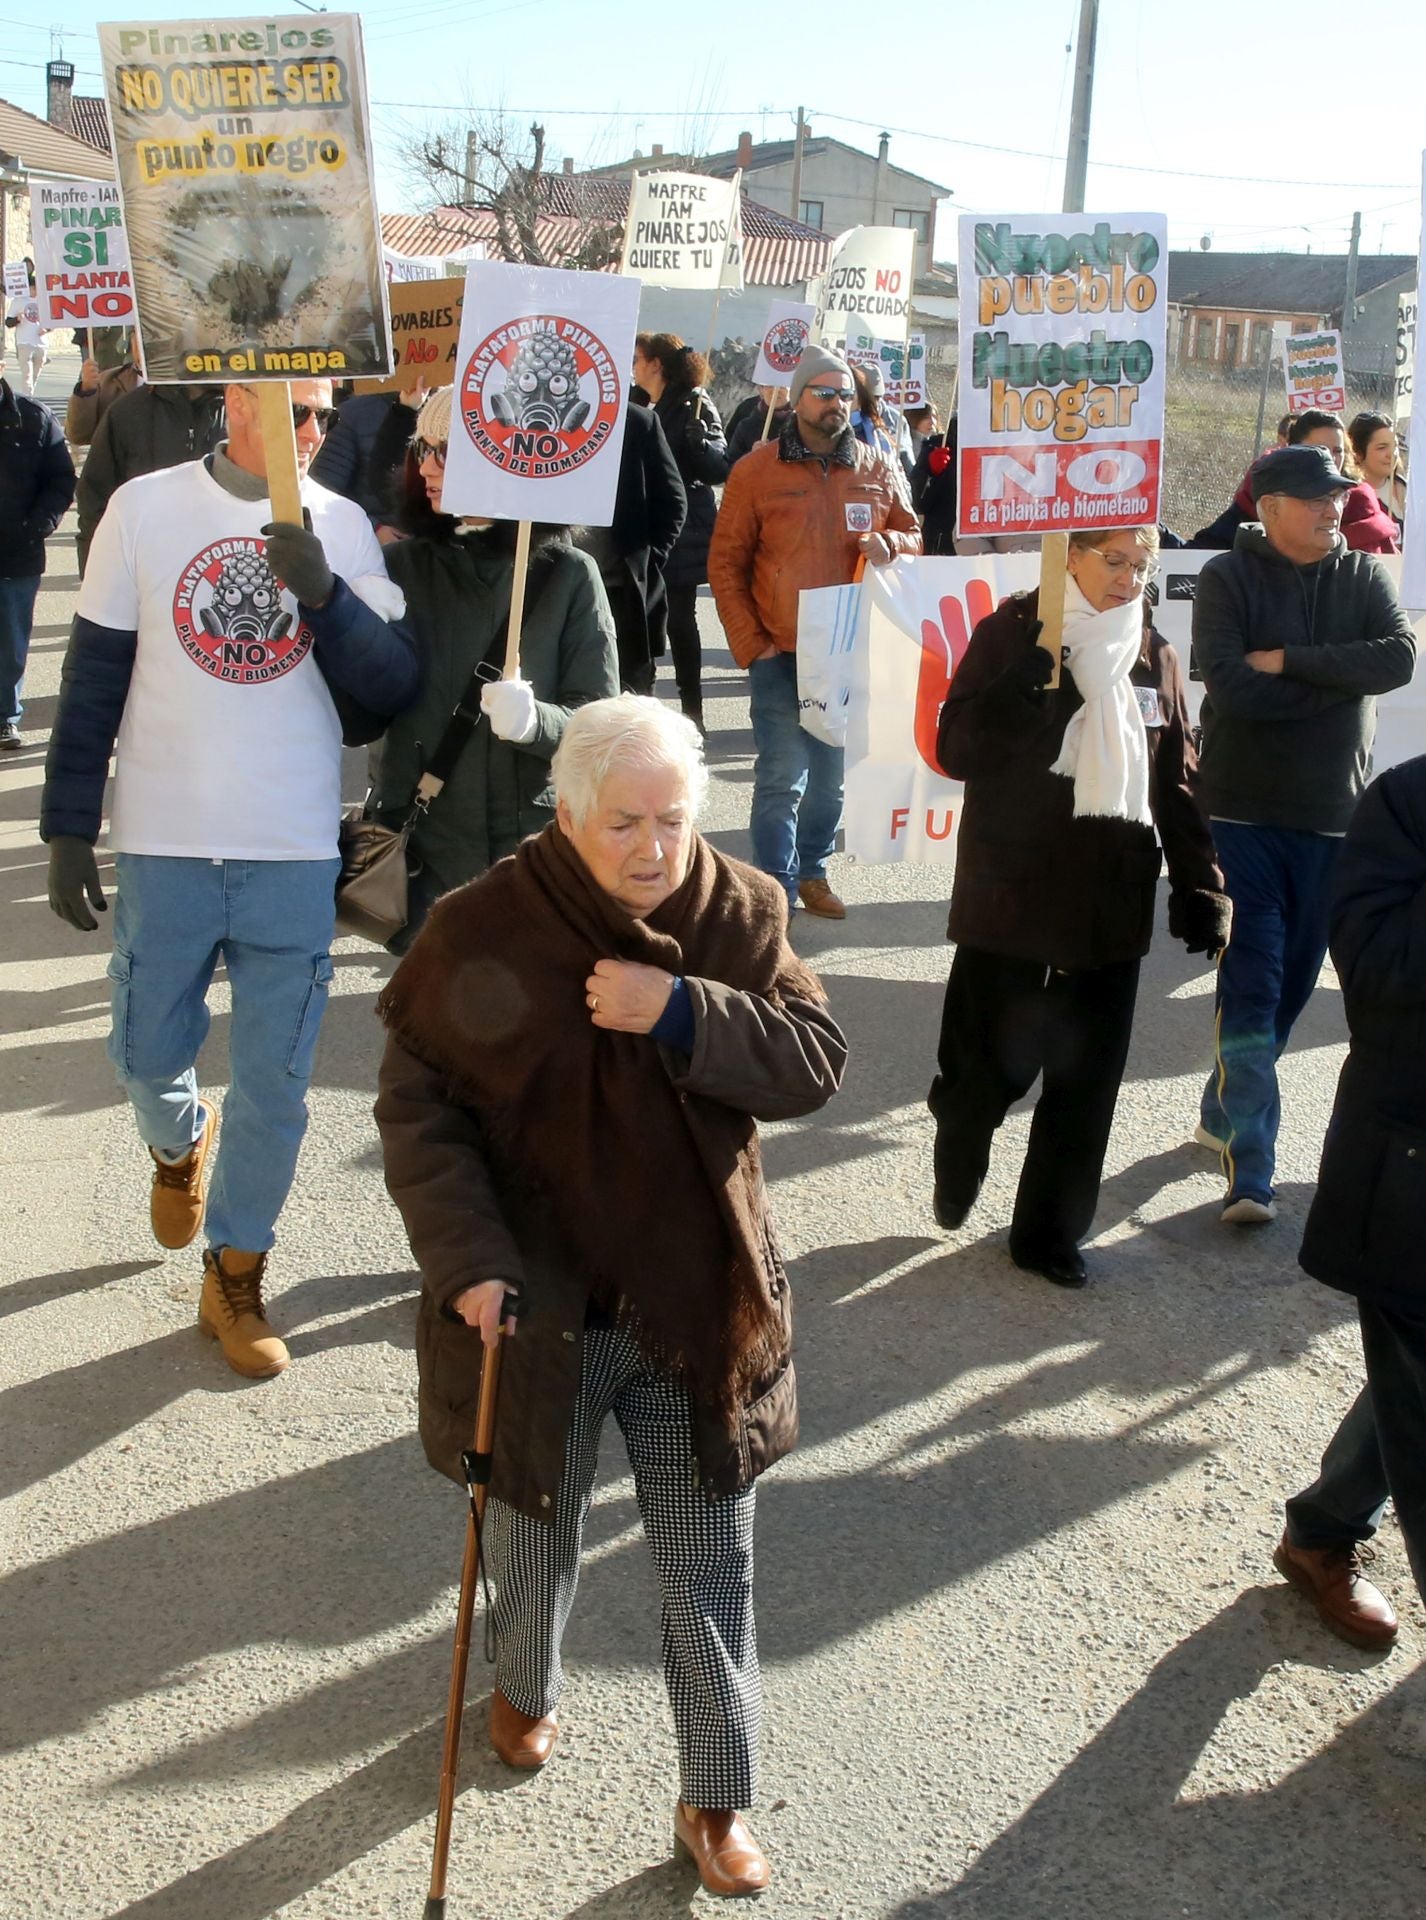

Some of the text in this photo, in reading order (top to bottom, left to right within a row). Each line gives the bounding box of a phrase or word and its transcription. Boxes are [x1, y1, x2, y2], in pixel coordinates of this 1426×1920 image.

[118, 24, 335, 57] Pinarejos
[121, 62, 344, 115] NO QUIERE SER
[217, 117, 254, 135] un
[144, 135, 340, 178] punto negro
[41, 188, 89, 206] Mapfre
[648, 182, 708, 202] MAPFRE
[661, 201, 693, 219] IAM
[635, 220, 728, 245] PINAREJOS
[629, 249, 681, 270] QUIERE
[690, 249, 713, 269] TU
[974, 222, 1160, 275] Nuestro
[45, 271, 131, 291] PLANTA
[875, 269, 902, 294] NO
[978, 264, 1157, 326] pueblo
[50, 292, 133, 320] NO
[185, 349, 347, 374] en el mapa
[404, 337, 439, 366] No
[467, 319, 617, 404] PLATAFORMA PINAREJOS
[847, 349, 879, 360] PLANTA
[972, 330, 1154, 389] Nuestro
[990, 379, 1139, 442] hogar
[1293, 391, 1341, 409] NO
[466, 410, 610, 475] PLANTA DE BIOMETANO
[512, 433, 560, 459] NO
[980, 449, 1147, 500] NO
[969, 495, 1149, 526] a la planta de biometano
[178, 540, 257, 609] PLATAFORMA
[179, 624, 312, 681] PLANTA DE BIOMETANO
[223, 643, 267, 666] NO
